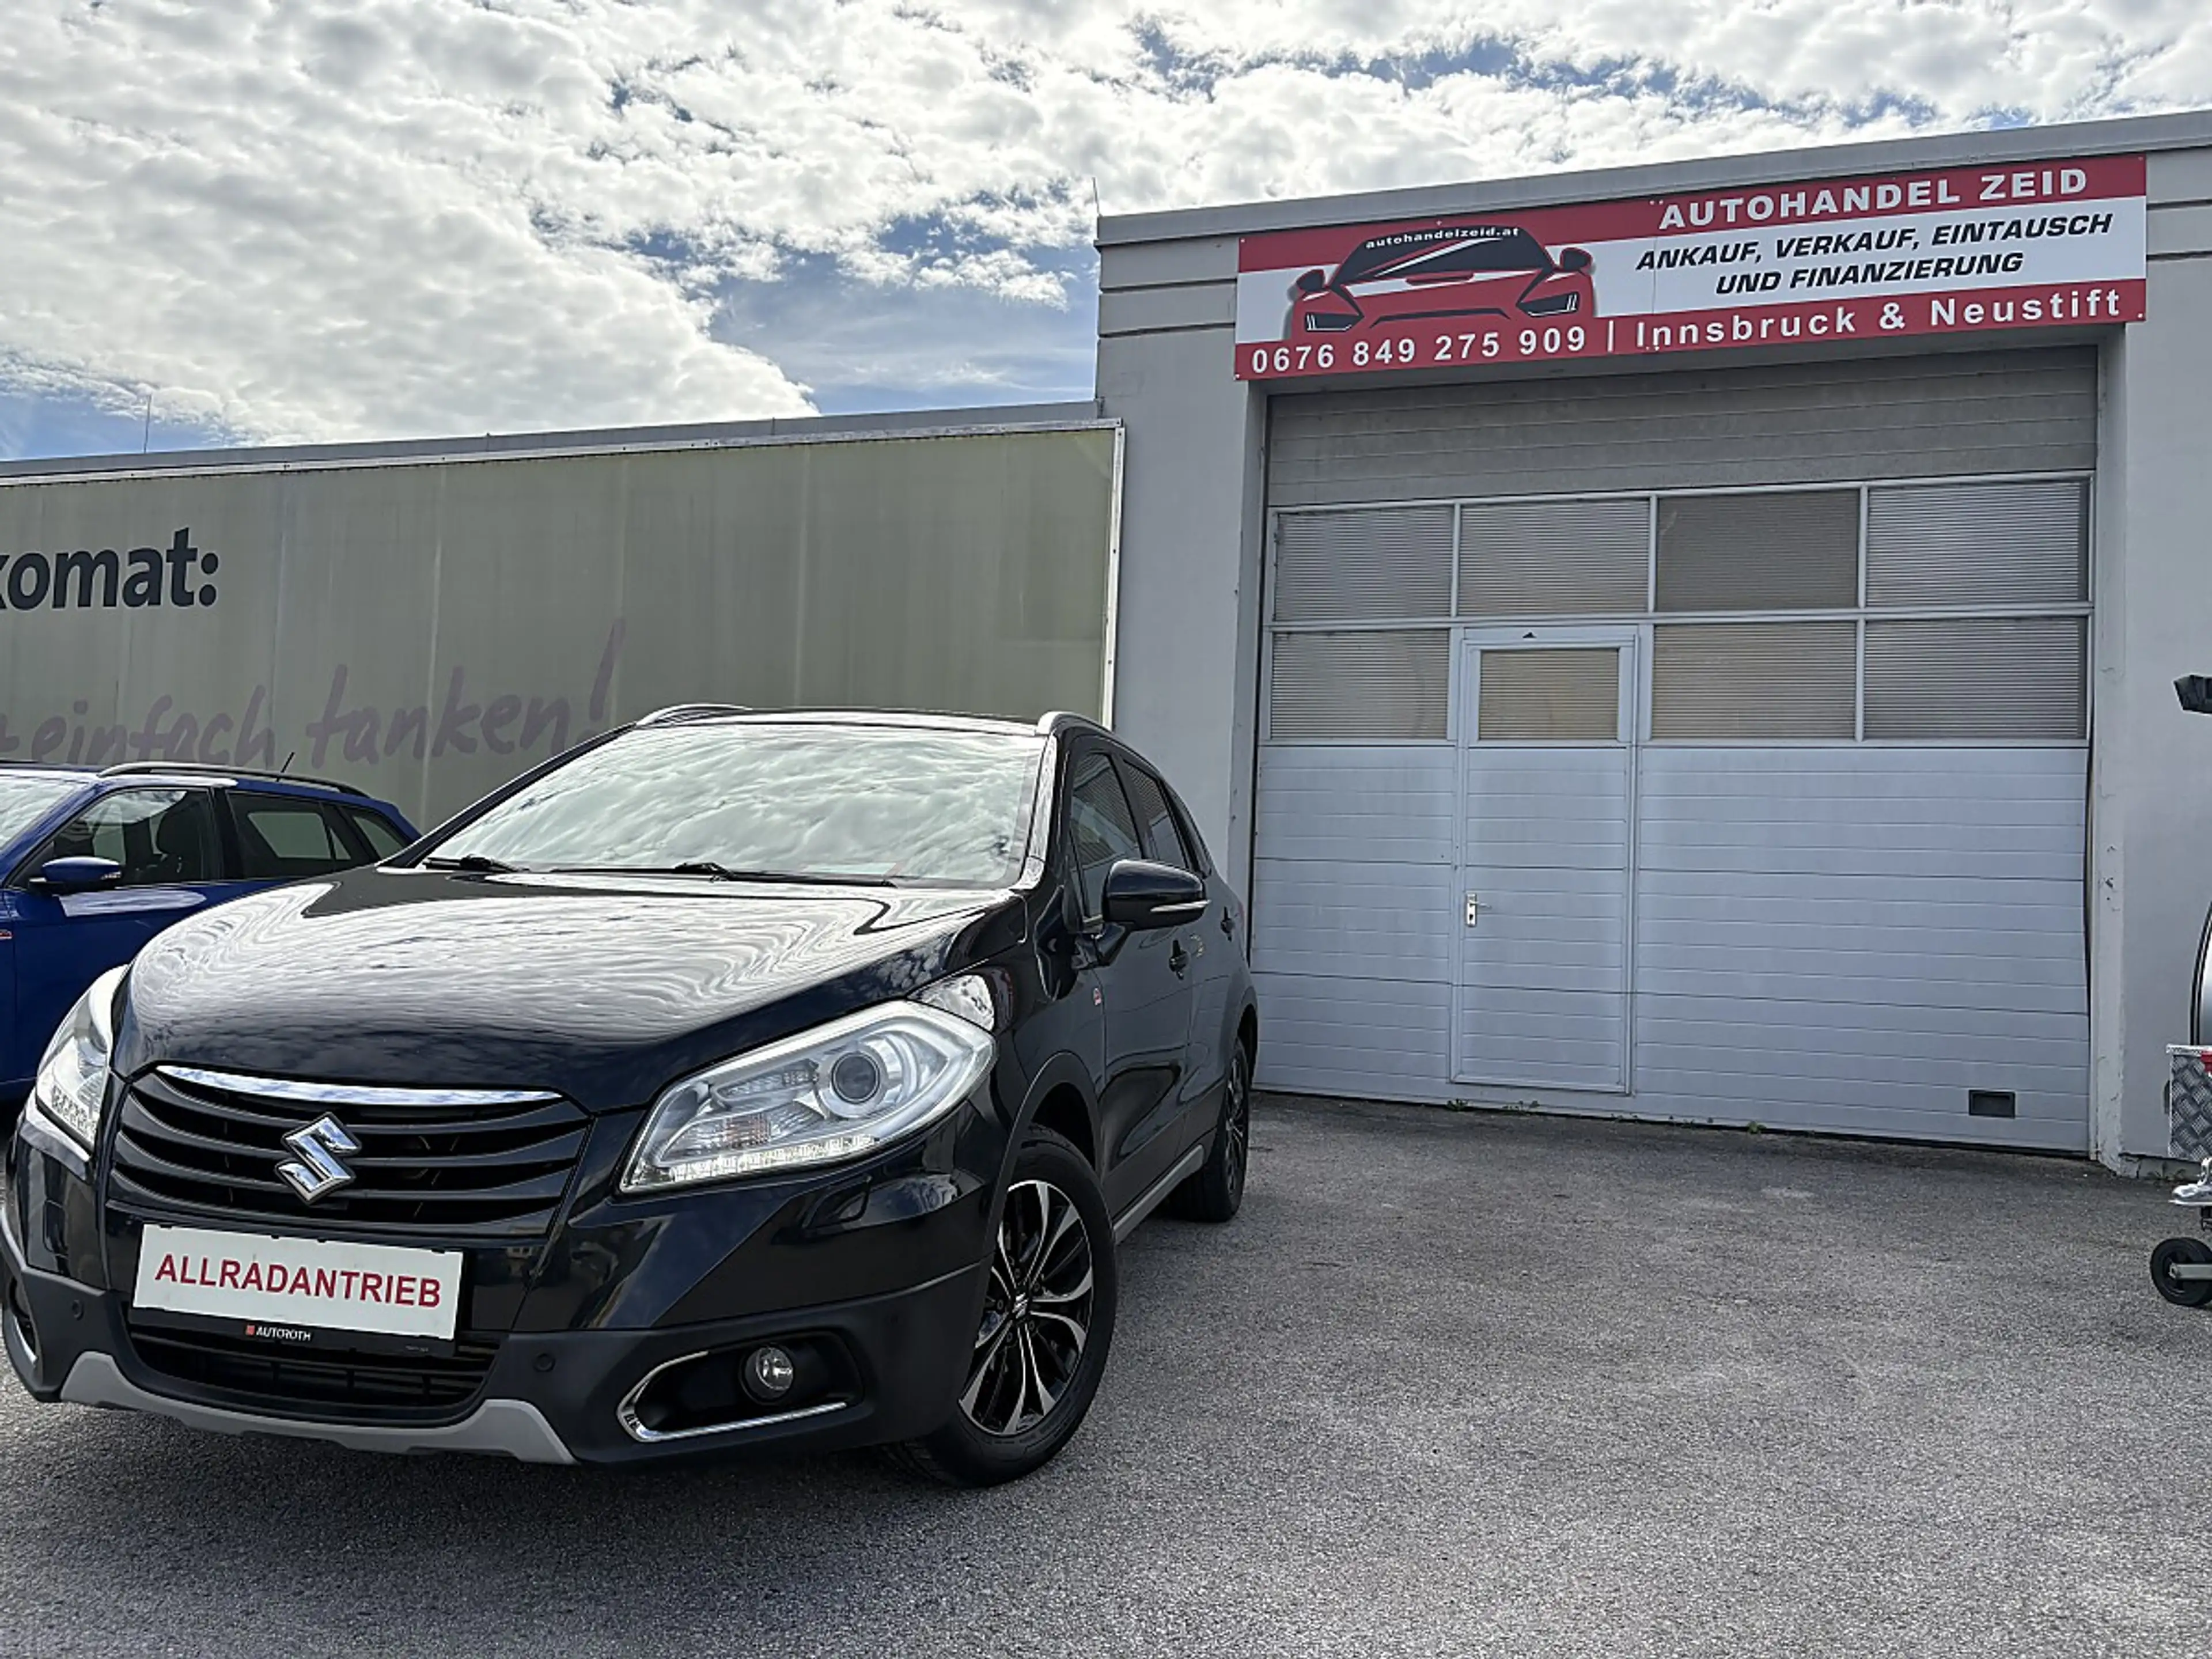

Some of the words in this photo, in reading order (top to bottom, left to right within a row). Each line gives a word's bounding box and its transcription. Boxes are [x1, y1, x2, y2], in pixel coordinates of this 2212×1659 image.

[1659, 179, 1960, 229] AUTOHANDEL
[1979, 169, 2088, 200] ZEID
[1365, 228, 1520, 249] autohandelzeid.at
[1636, 241, 1763, 270] ANKAUF,
[1776, 228, 1921, 259] VERKAUF,
[1931, 214, 2113, 246] EINTAUSCH
[1715, 271, 1781, 295] UND
[1789, 252, 2024, 289] FINANZIERUNG
[1252, 344, 1334, 373] 0676
[1353, 339, 1415, 366] 849
[1434, 331, 1499, 361] 275
[1519, 325, 1585, 355] 909
[1637, 306, 1856, 347] Innsbruck
[1879, 302, 1906, 330] &
[1931, 289, 2121, 326] Neustift
[305, 616, 626, 769] tanken!
[154, 1253, 441, 1308] ALLRADANTRIEB
